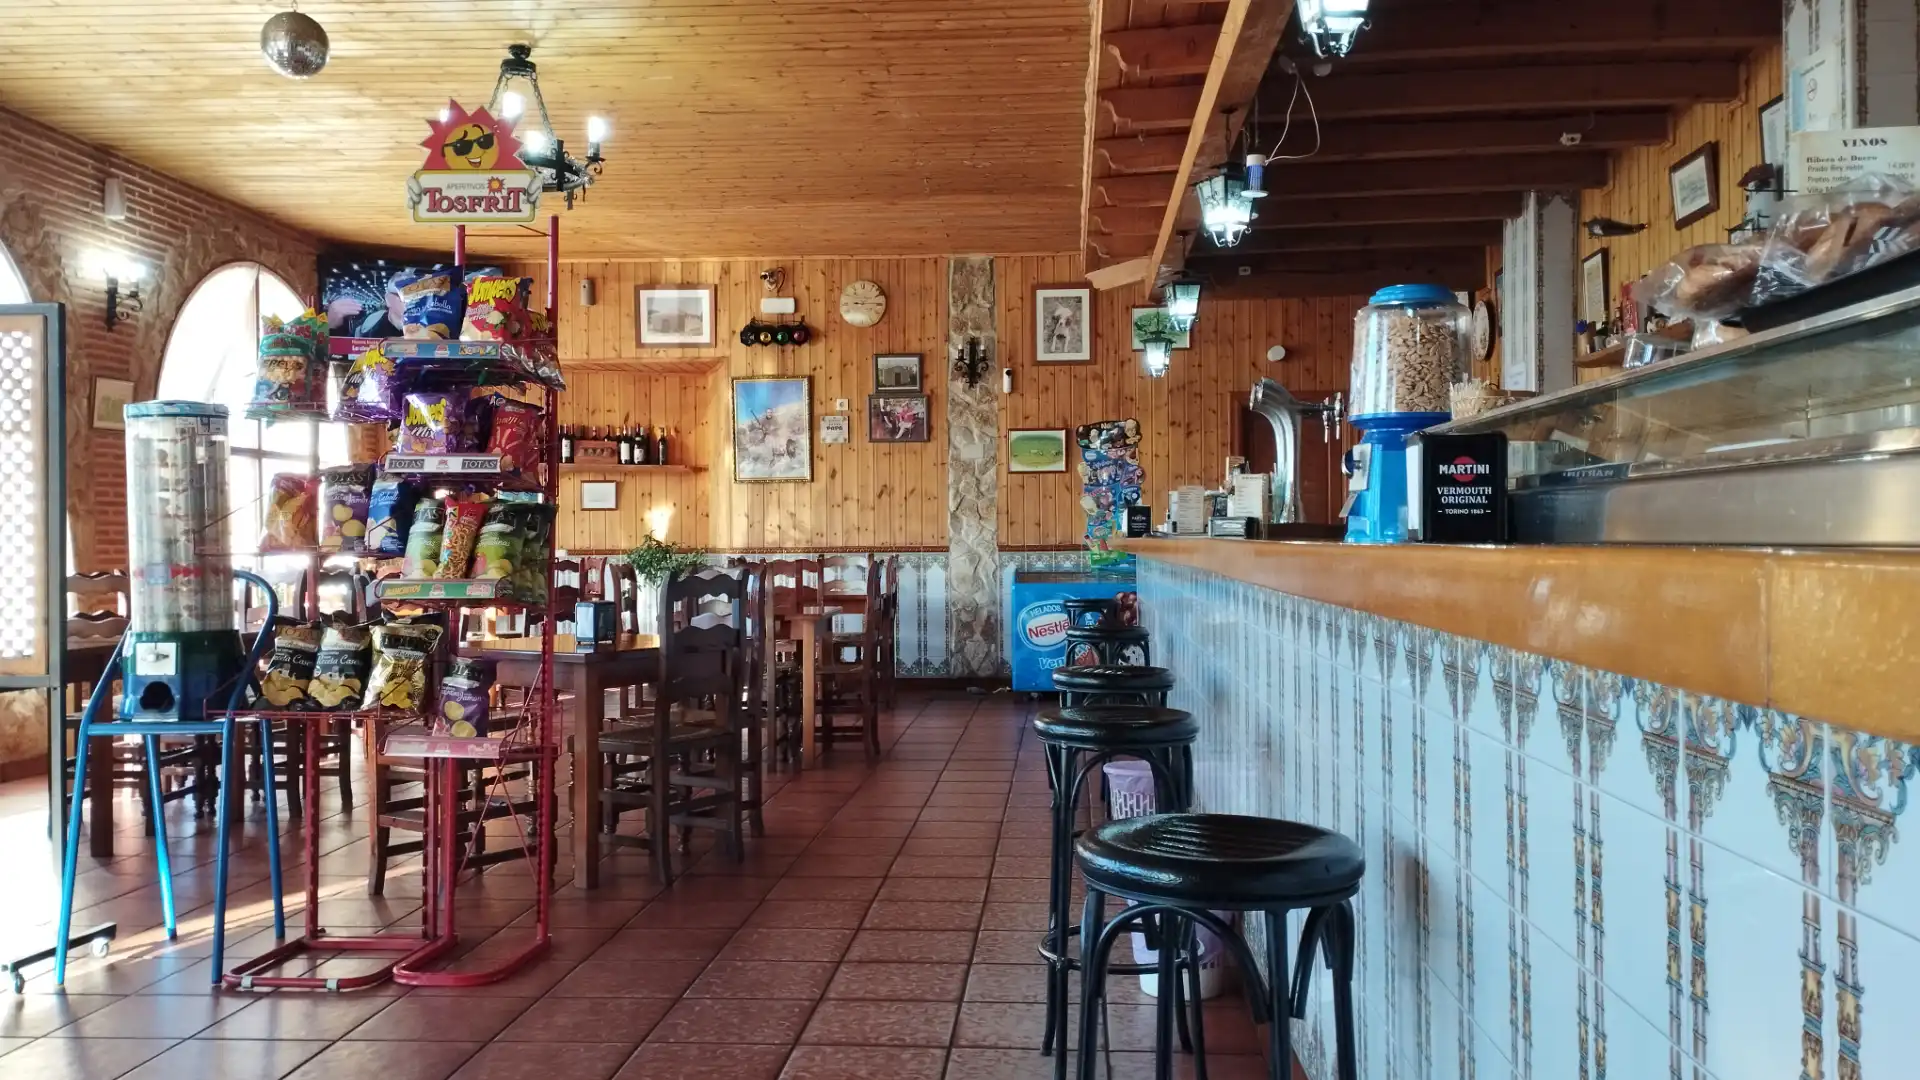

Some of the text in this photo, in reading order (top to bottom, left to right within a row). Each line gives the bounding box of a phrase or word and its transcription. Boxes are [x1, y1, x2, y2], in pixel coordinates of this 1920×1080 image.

[1841, 138, 1887, 147] VINOS
[422, 187, 526, 213] TOSFRIT
[411, 426, 436, 439] Mix
[391, 461, 423, 469] TOTAS
[464, 461, 497, 469] TOTAS
[1439, 464, 1489, 475] MARTINI
[1437, 487, 1492, 495] VERMOUTH
[1441, 495, 1488, 504] ORIGINAL
[1030, 604, 1062, 618] HELADOS
[317, 654, 339, 665] Receta
